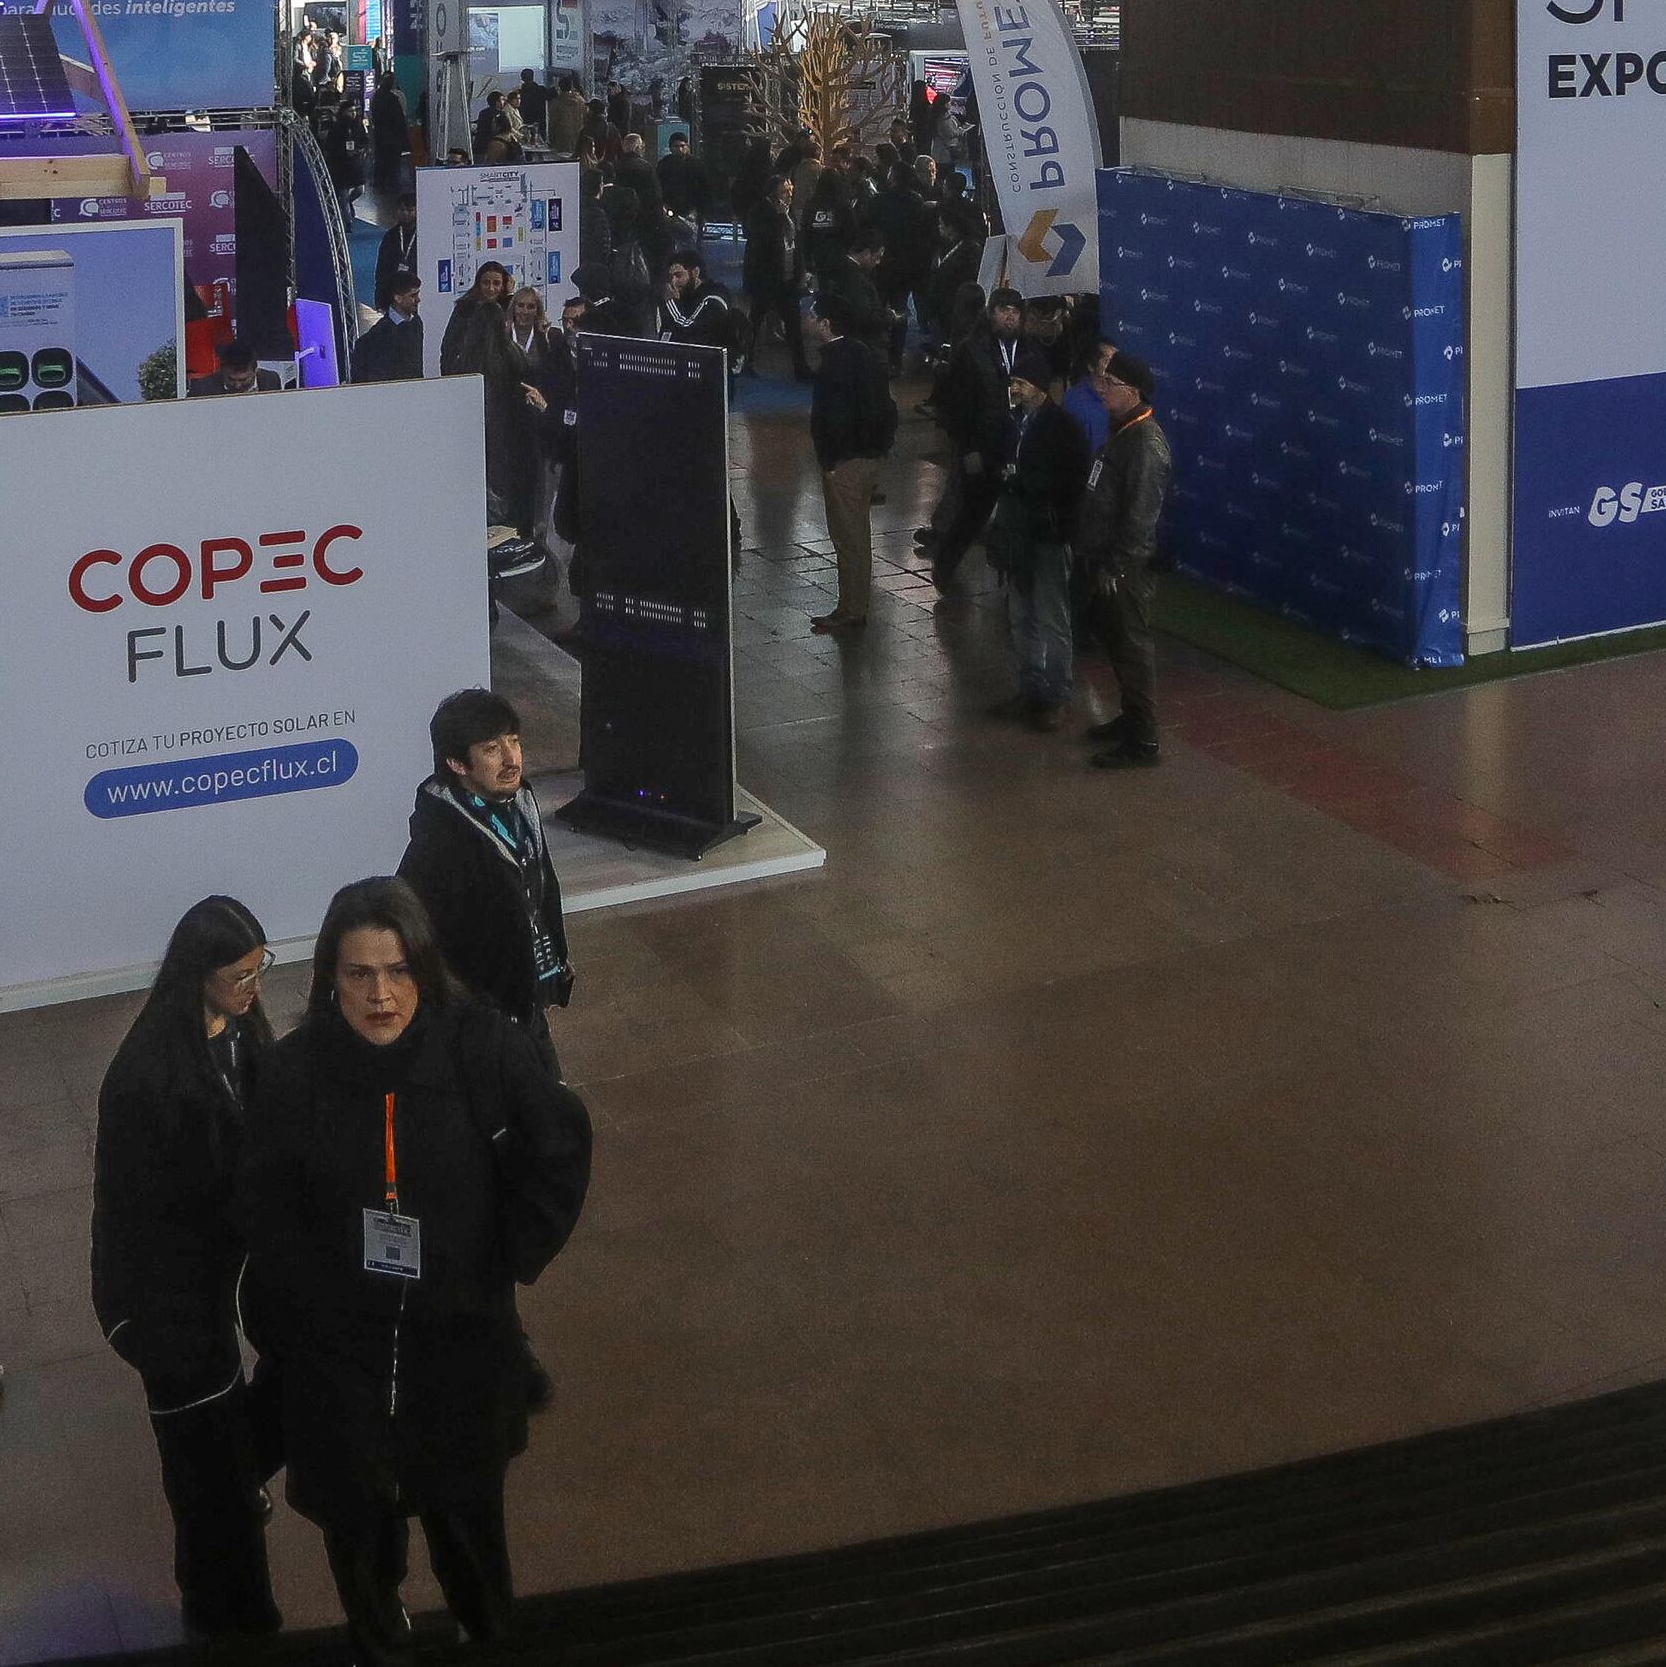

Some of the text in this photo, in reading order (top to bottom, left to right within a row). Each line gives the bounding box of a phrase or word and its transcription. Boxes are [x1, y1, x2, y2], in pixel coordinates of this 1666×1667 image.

[144, 199, 193, 213] SERCOTEC
[1413, 217, 1447, 231] PROMET
[1548, 505, 1581, 519] INVITAN
[1587, 481, 1643, 528] GS
[68, 524, 364, 614] COPEC
[127, 609, 313, 684] FLUX
[85, 708, 357, 760] COTIZA TU PROYECTO SOLAR EN
[107, 749, 339, 805] www.copecflux.cl
